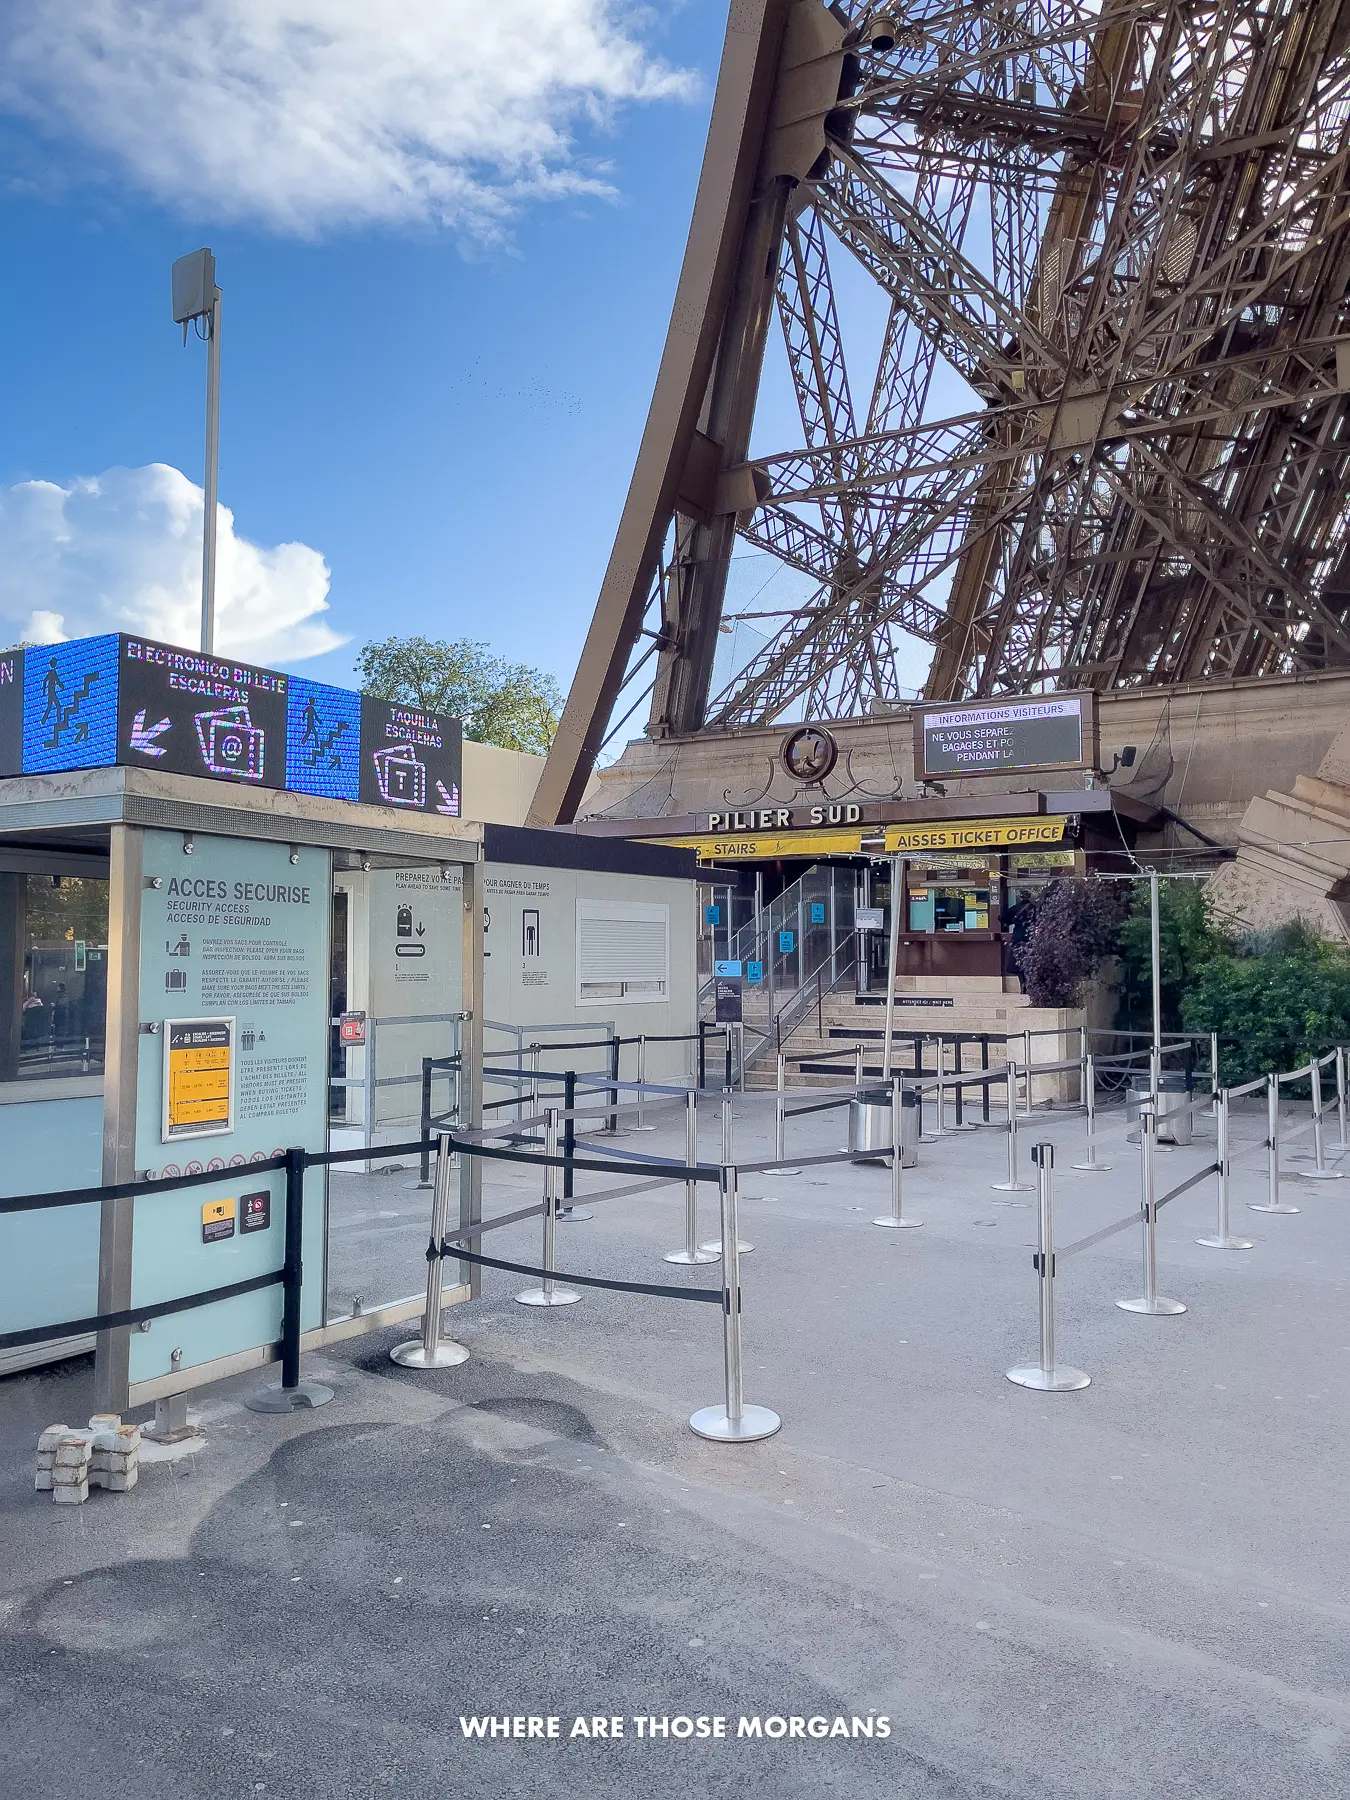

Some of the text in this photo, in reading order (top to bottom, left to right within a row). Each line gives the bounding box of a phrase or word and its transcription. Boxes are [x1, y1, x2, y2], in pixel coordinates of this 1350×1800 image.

[170, 673, 249, 703] ESCALERAS
[233, 668, 285, 694] BILLETE
[390, 708, 438, 731] TAQUILLA
[939, 705, 1064, 724] INFORMATIONS VISITEURS
[386, 724, 442, 748] ESCALERAS
[932, 726, 1015, 742] NE VOUS SEPAREZ
[942, 741, 984, 752] BAGAGES
[986, 740, 998, 748] ET
[957, 751, 1000, 762] PENDANT
[708, 804, 860, 831] PILIER SUD
[951, 830, 1001, 845] TICKET
[1006, 826, 1060, 841] OFFICE
[714, 843, 756, 855] STAIRS
[167, 877, 310, 904] ACCES SECURISE
[500, 880, 522, 889] GAGNER
[524, 881, 532, 889] DU
[532, 882, 550, 890] TEMPS
[167, 901, 250, 913] SECURITY ACCESS
[167, 913, 271, 926] ACCESO DE SEGURIDAD
[275, 1092, 307, 1100] VISITANTES
[278, 1100, 307, 1108] PRESENTES
[248, 1110, 274, 1119] COMPRAR
